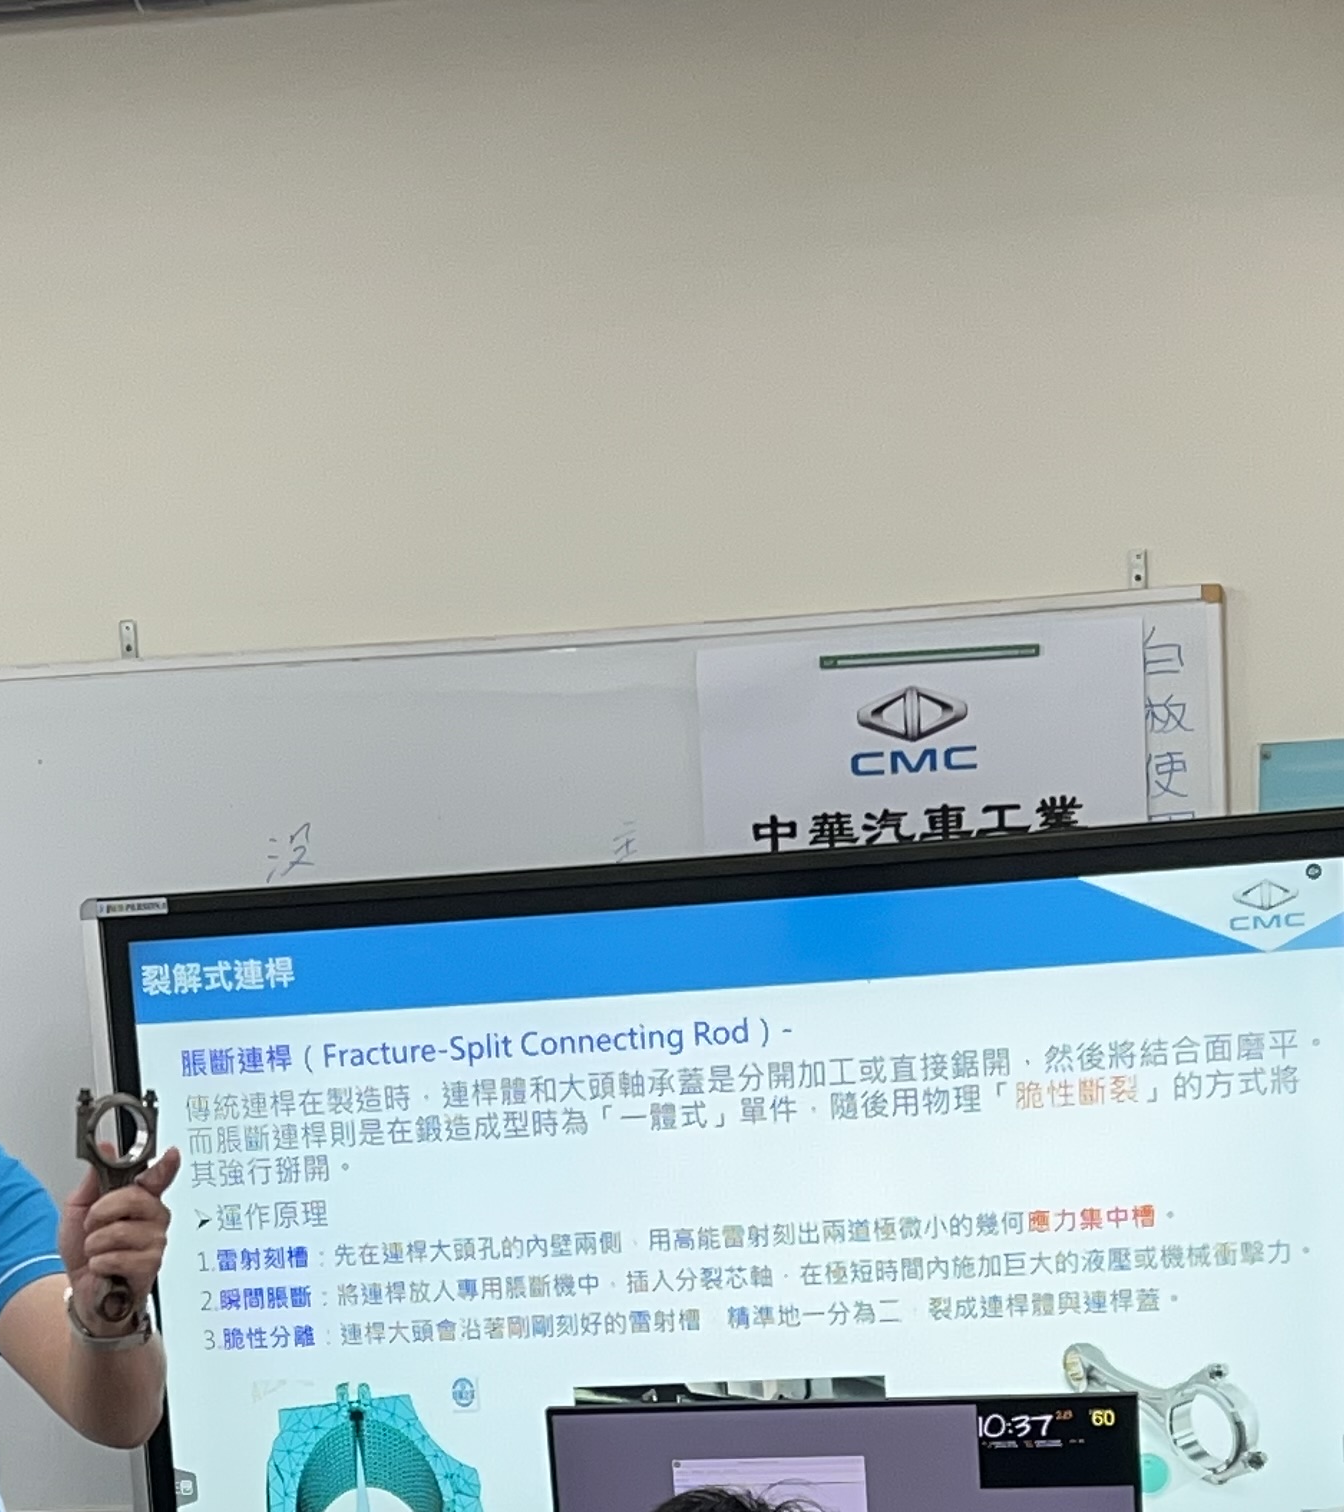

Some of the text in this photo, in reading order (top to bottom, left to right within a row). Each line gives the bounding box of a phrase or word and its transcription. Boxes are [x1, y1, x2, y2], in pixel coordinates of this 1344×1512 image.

[851, 745, 978, 777] CMC
[752, 794, 1089, 852] 中華汽車工業
[1229, 912, 1306, 932] CMC
[141, 956, 296, 996] 裂解式連桿
[520, 1023, 684, 1056] Connecting
[216, 1200, 329, 1232] 運作原理
[978, 1413, 1054, 1438] 10:37
